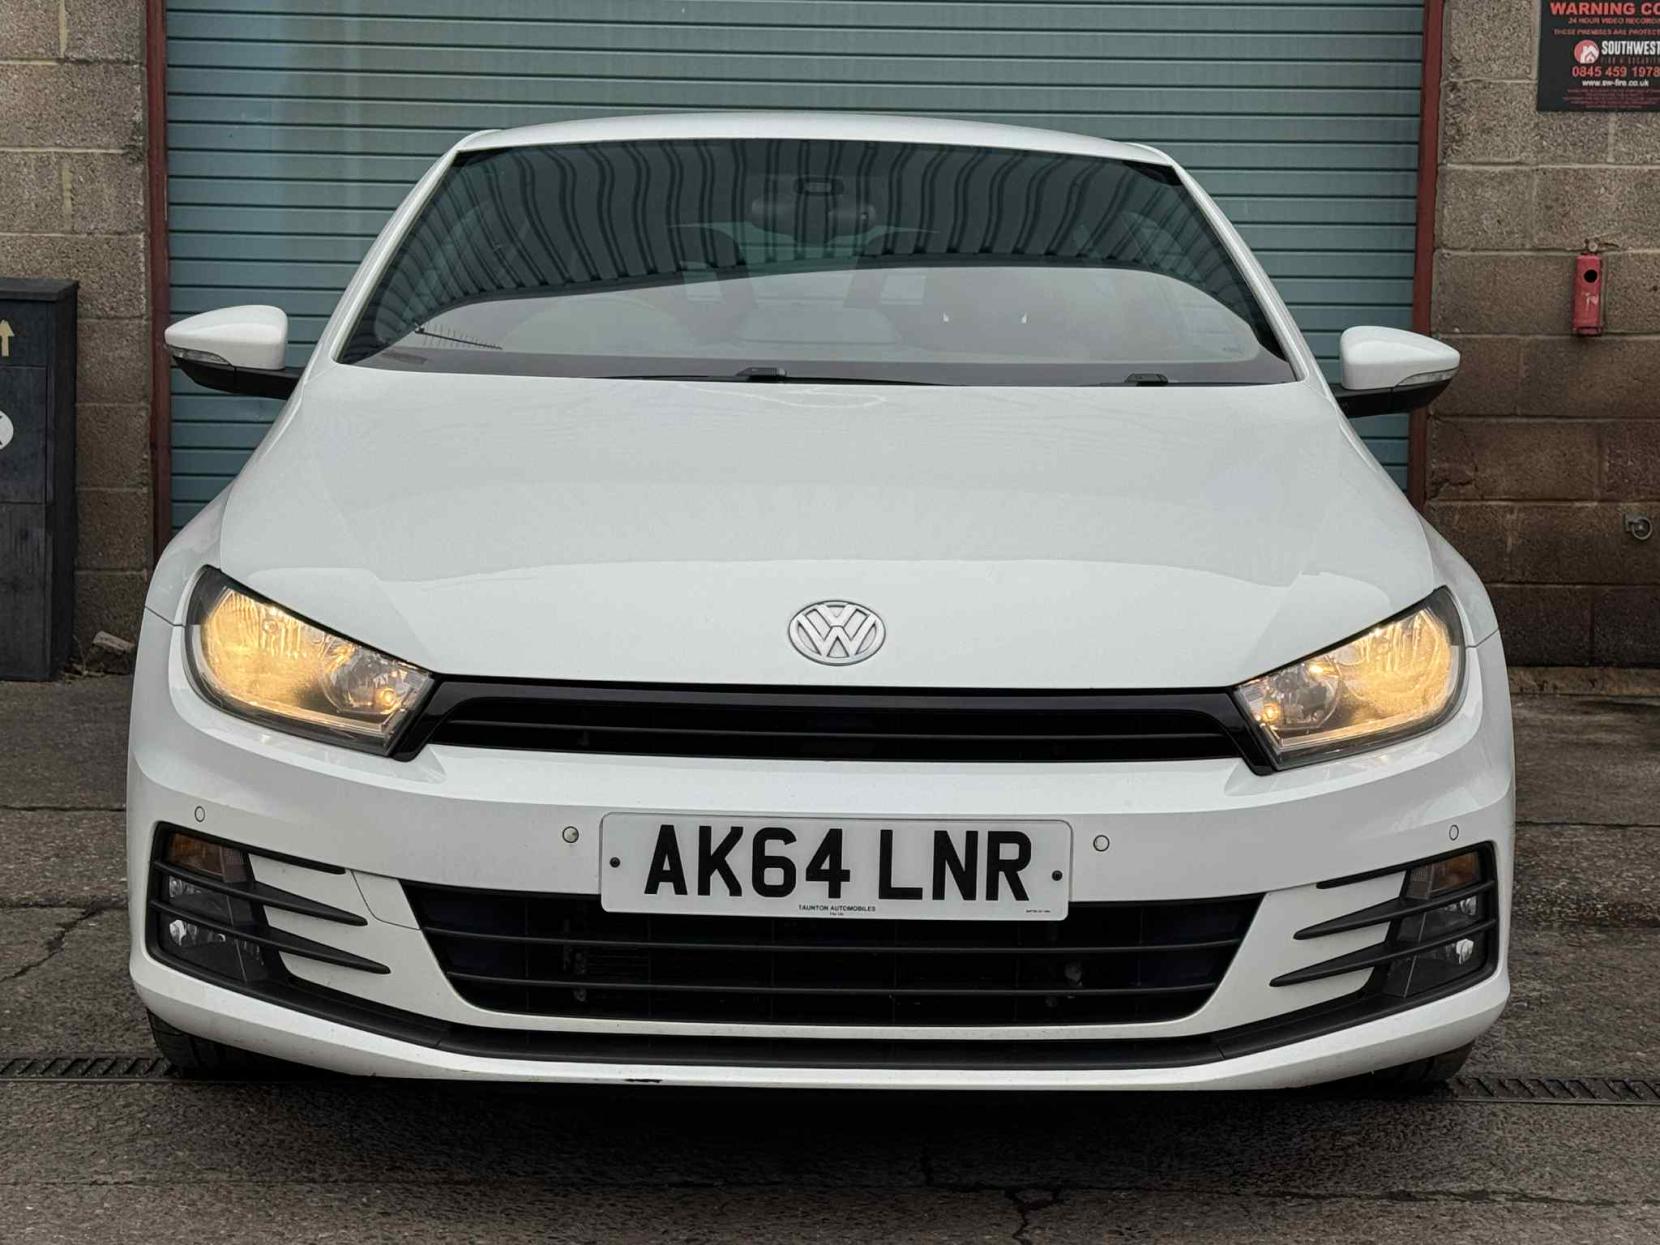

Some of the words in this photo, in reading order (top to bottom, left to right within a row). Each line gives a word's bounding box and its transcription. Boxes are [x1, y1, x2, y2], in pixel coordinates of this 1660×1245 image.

[1550, 2, 1636, 15] WARNING
[1601, 17, 1624, 25] VIDEO
[1601, 40, 1660, 55] SOUTHWEST
[1572, 66, 1602, 77] 0845
[1605, 66, 1627, 77] 459
[1632, 66, 1660, 77] 1978
[1582, 79, 1649, 87] www.sw-fire.co.uk
[643, 823, 851, 898] AK64
[878, 829, 1032, 902] LNR
[798, 904, 829, 912] TAUNTON
[830, 904, 877, 912] AUTOMOBILES
